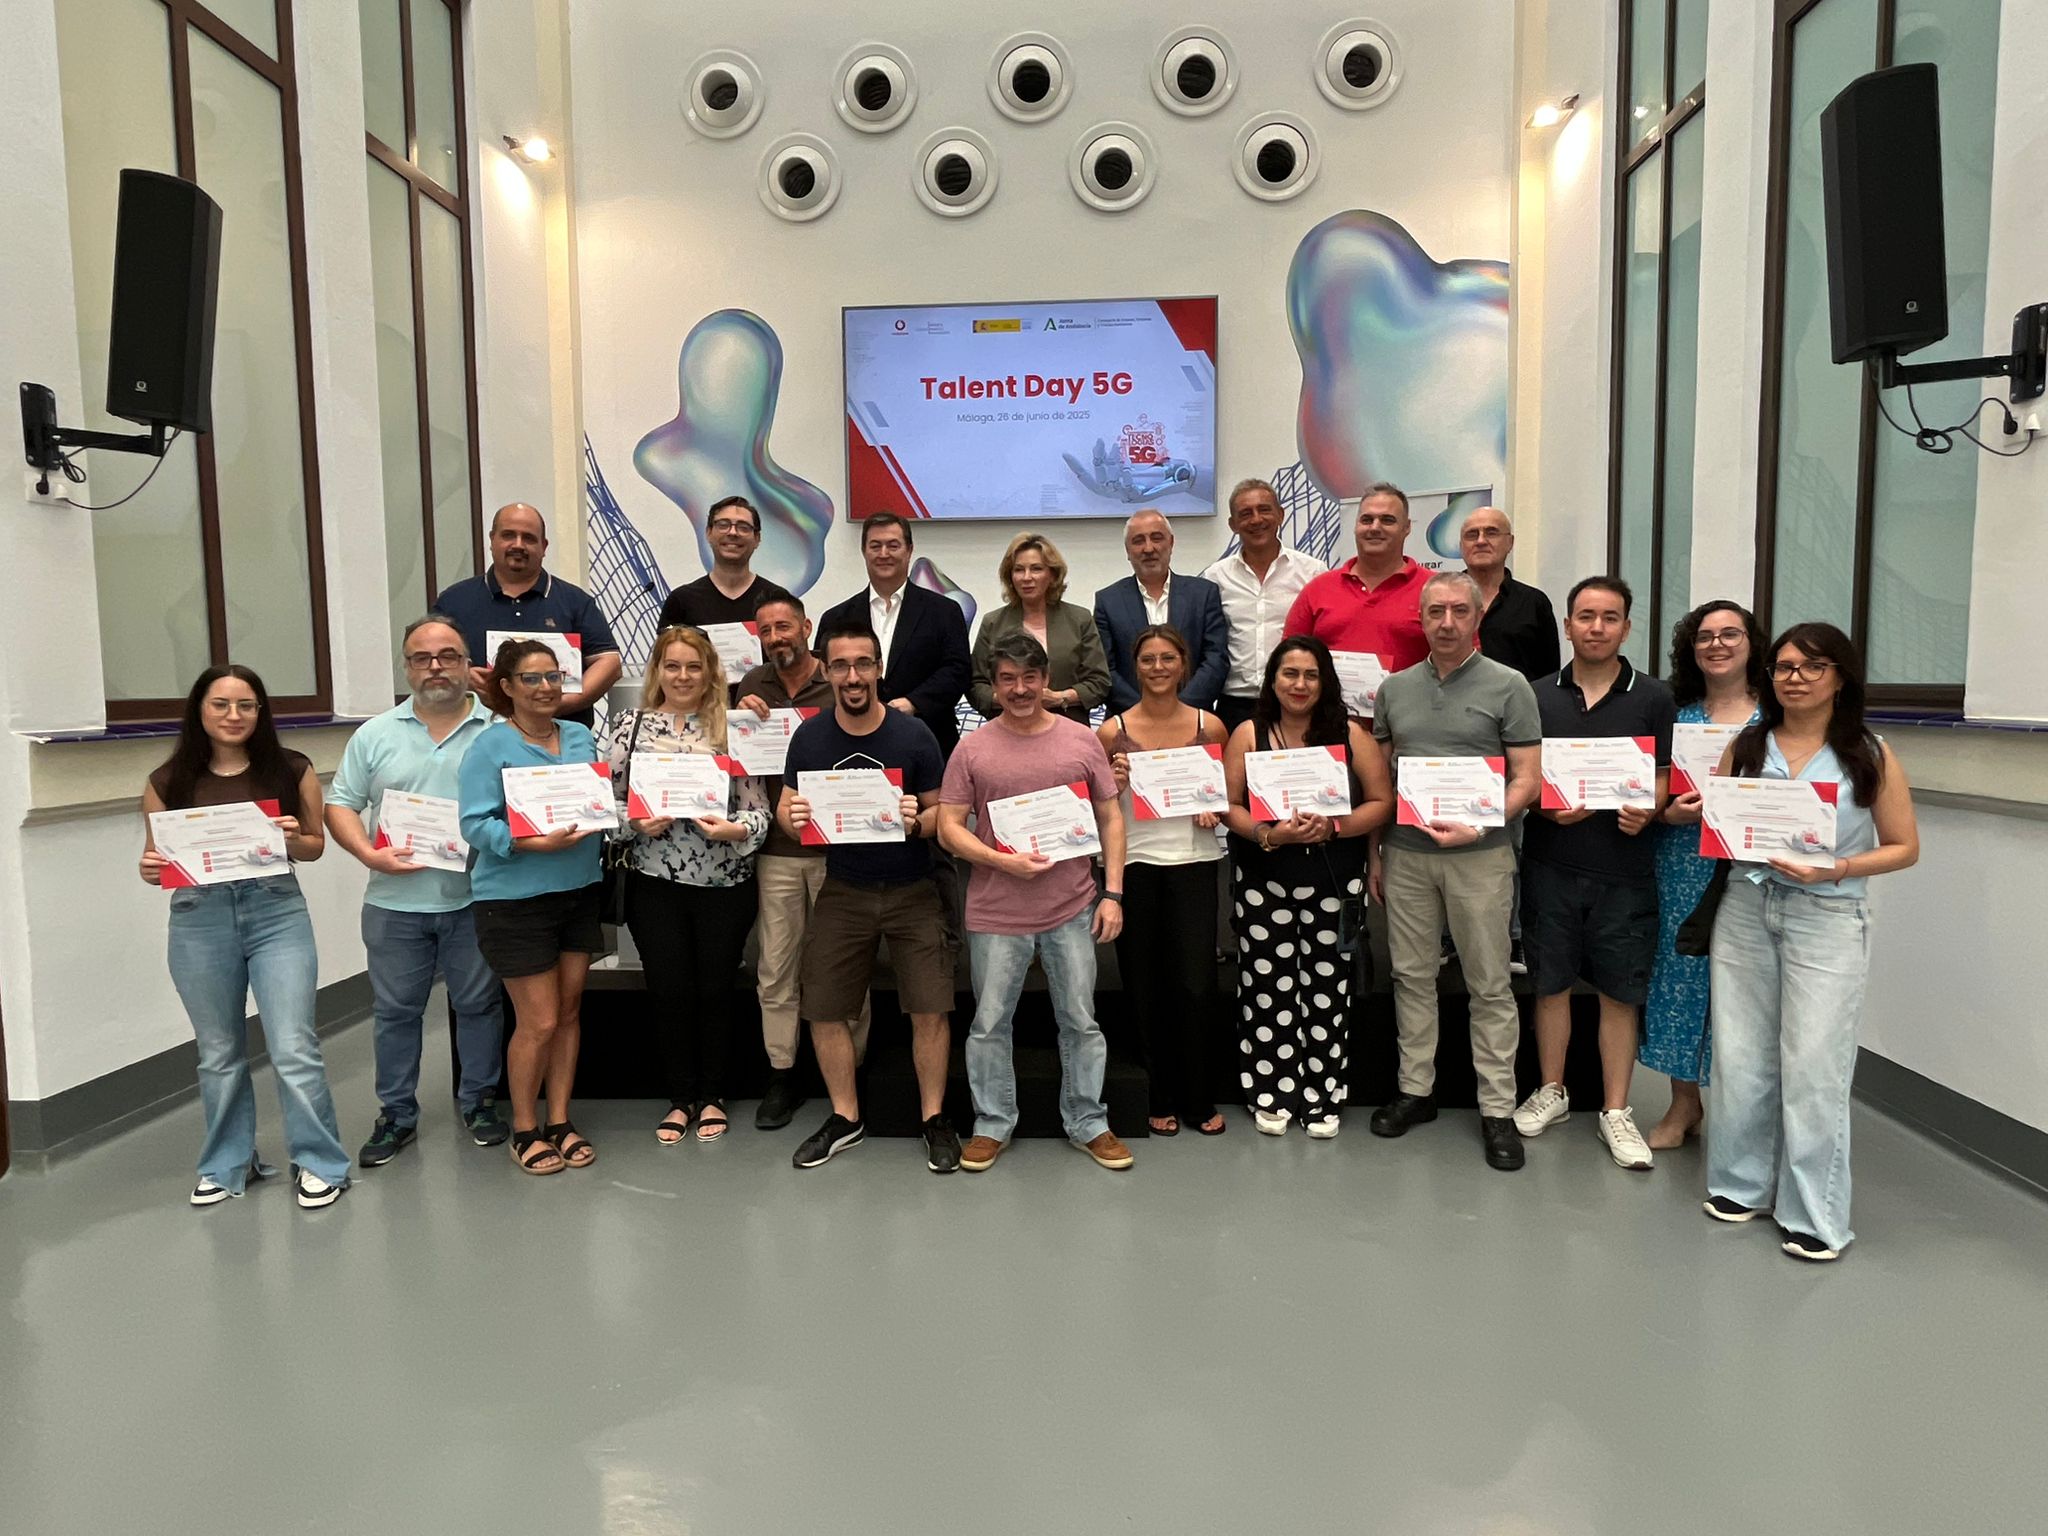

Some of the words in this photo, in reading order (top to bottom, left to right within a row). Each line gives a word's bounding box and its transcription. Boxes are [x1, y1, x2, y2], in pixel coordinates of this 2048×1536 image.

[919, 375, 1017, 400] Talent
[1024, 374, 1086, 405] Day
[1092, 371, 1133, 396] 5G
[1011, 412, 1025, 421] de
[1026, 411, 1050, 423] junio
[1051, 410, 1065, 421] de
[1067, 409, 1091, 421] 2025
